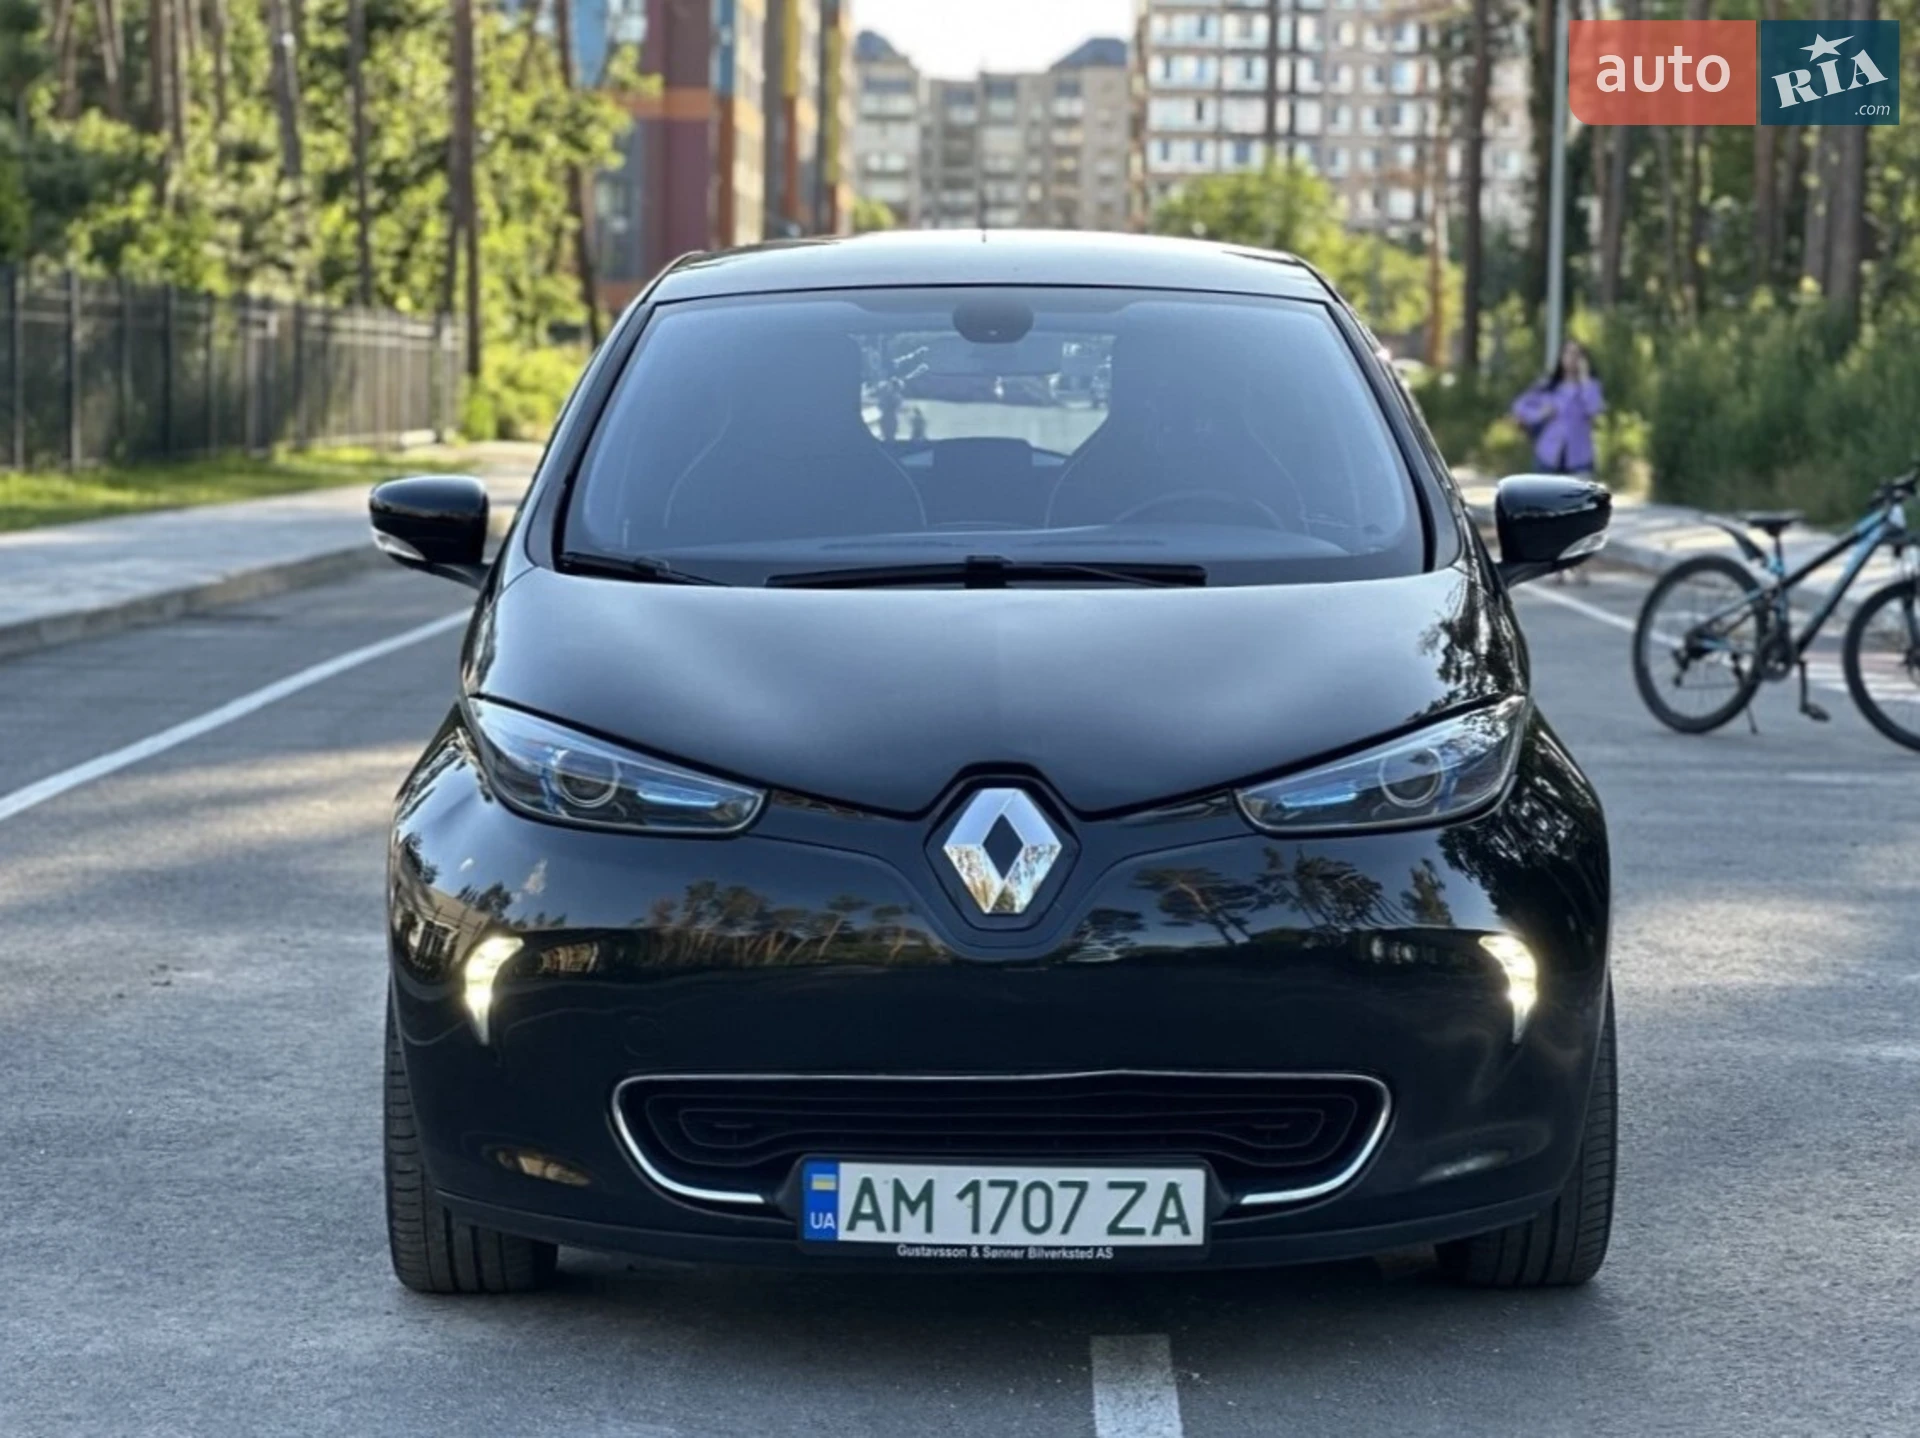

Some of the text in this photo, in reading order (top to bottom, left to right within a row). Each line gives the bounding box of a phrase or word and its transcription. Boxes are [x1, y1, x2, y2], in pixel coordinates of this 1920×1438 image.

[845, 1176, 1192, 1237] AM 1707 ZA
[810, 1211, 836, 1229] UA
[896, 1243, 968, 1258] Gustavsson
[970, 1245, 980, 1259] &
[1027, 1246, 1095, 1260] Bilverksted
[1095, 1246, 1114, 1260] AS
